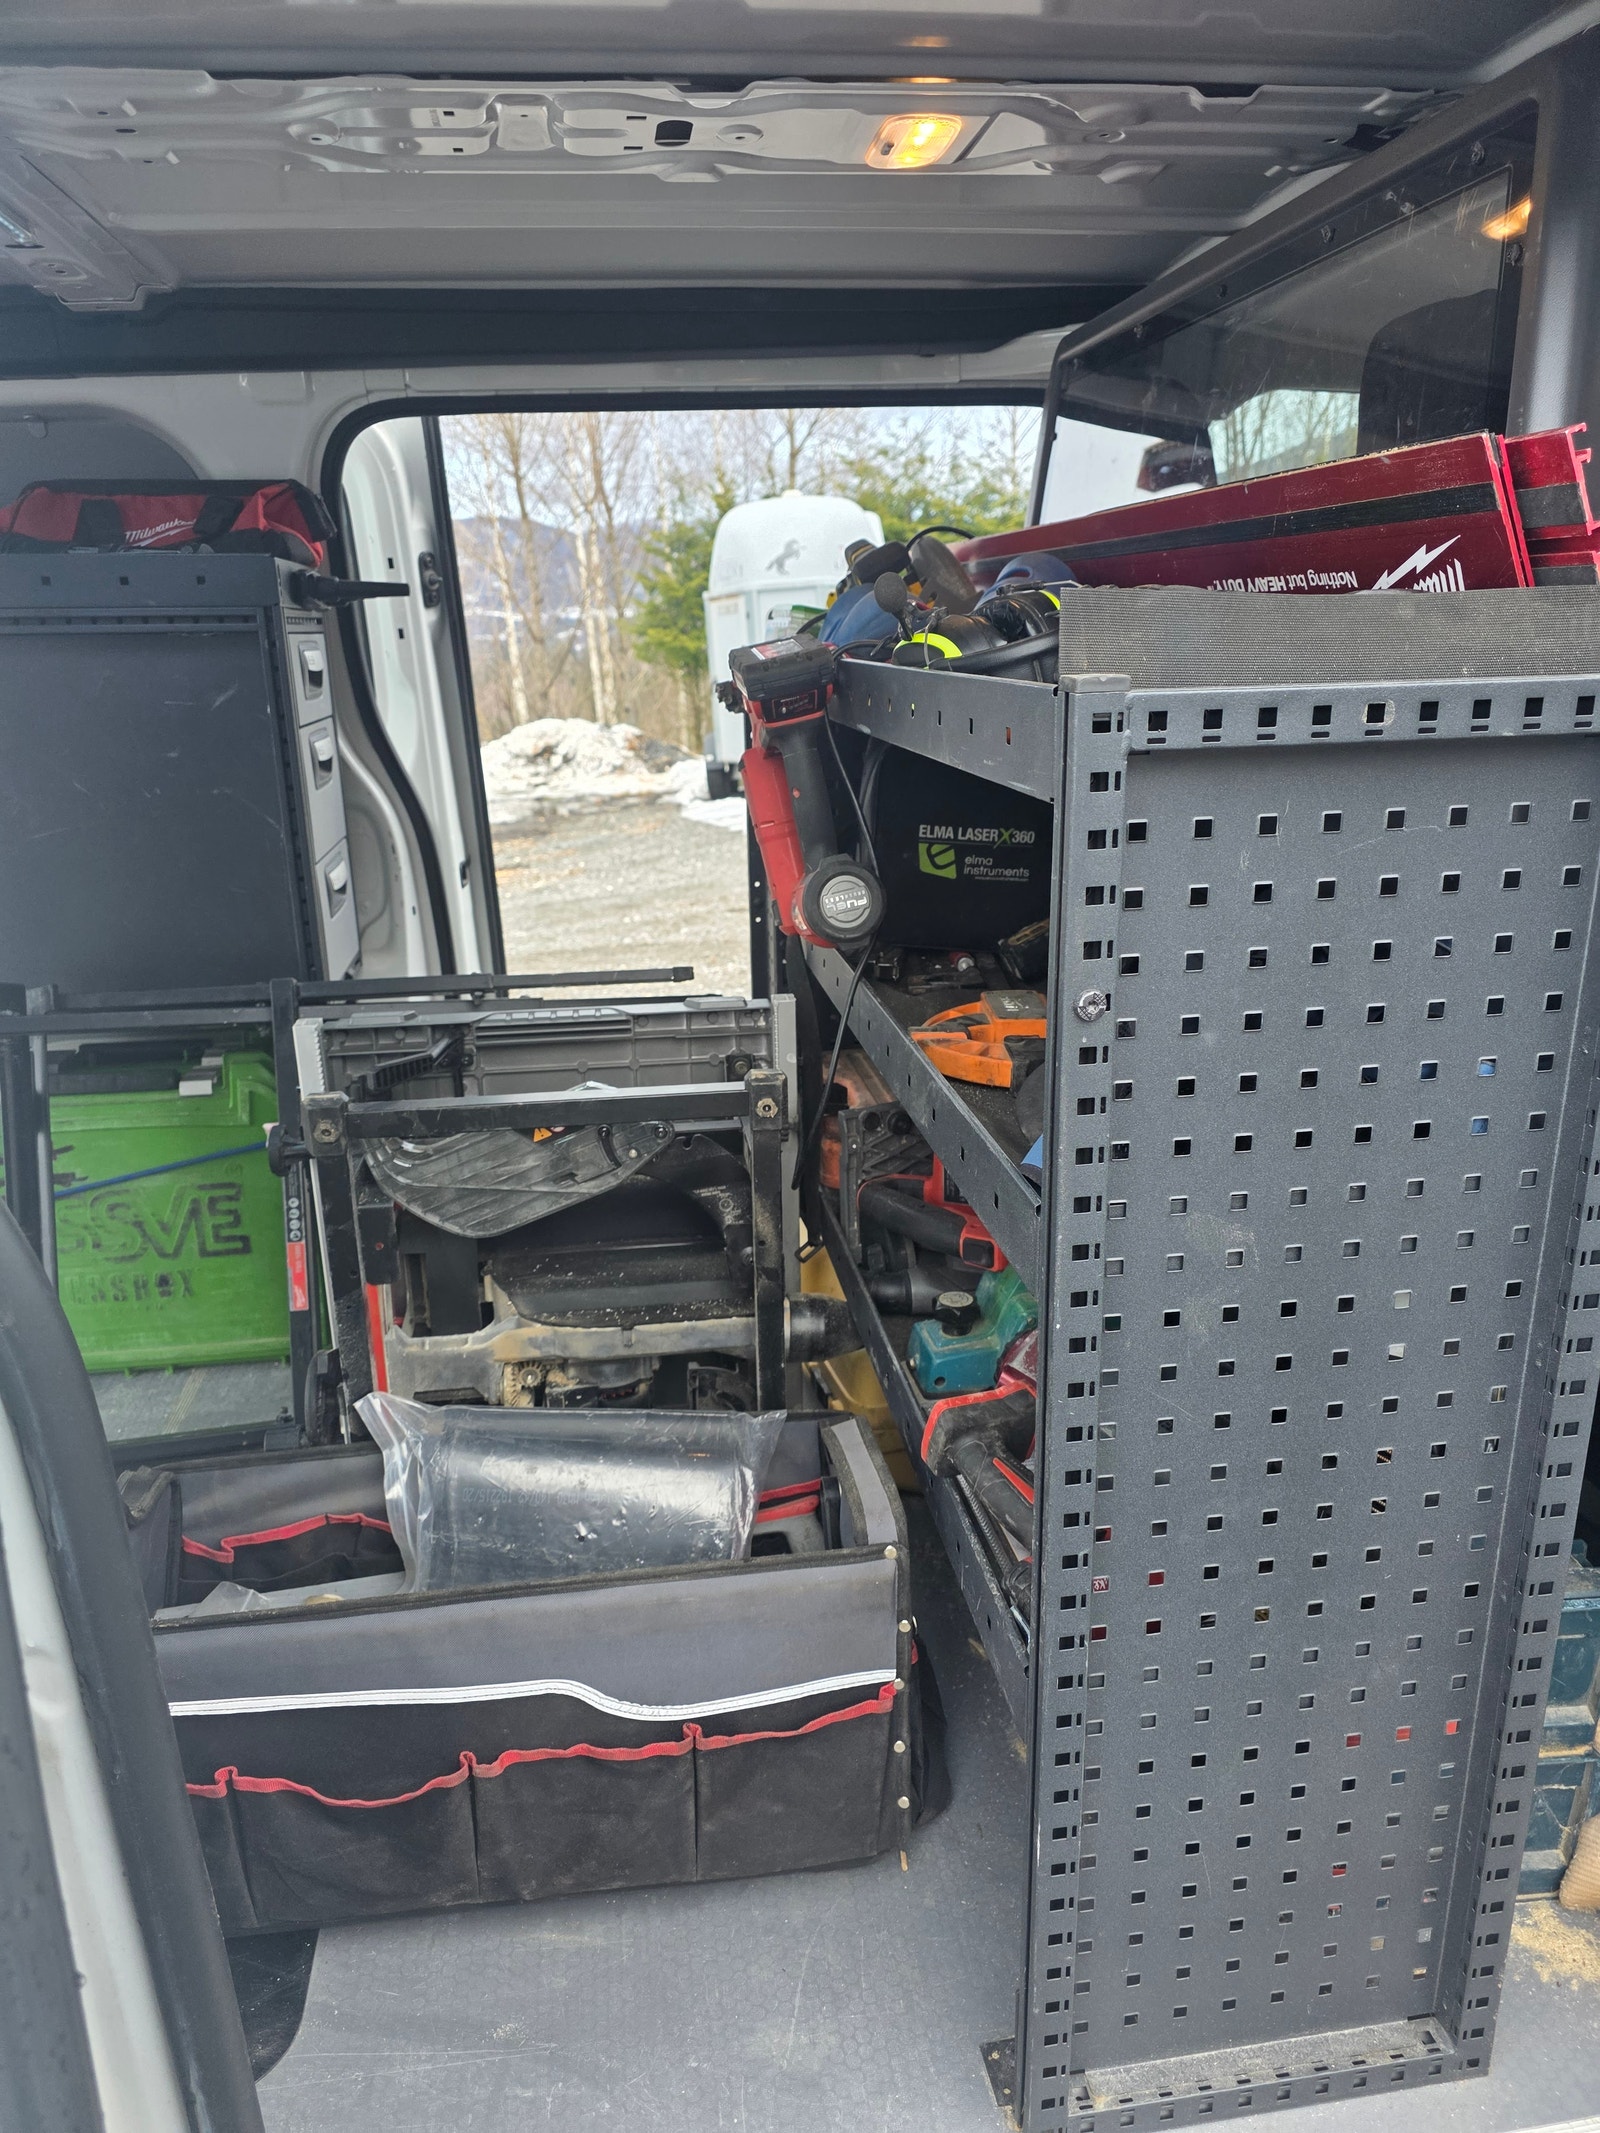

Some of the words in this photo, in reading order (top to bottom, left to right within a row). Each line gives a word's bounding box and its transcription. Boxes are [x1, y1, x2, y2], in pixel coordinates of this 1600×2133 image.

[1247, 576, 1287, 592] HEAVY
[1288, 574, 1307, 590] but
[1307, 569, 1358, 589] Nothing
[918, 824, 955, 840] ELMA
[964, 854, 993, 866] elma
[963, 864, 1030, 878] instruments
[826, 896, 867, 911] FUEL
